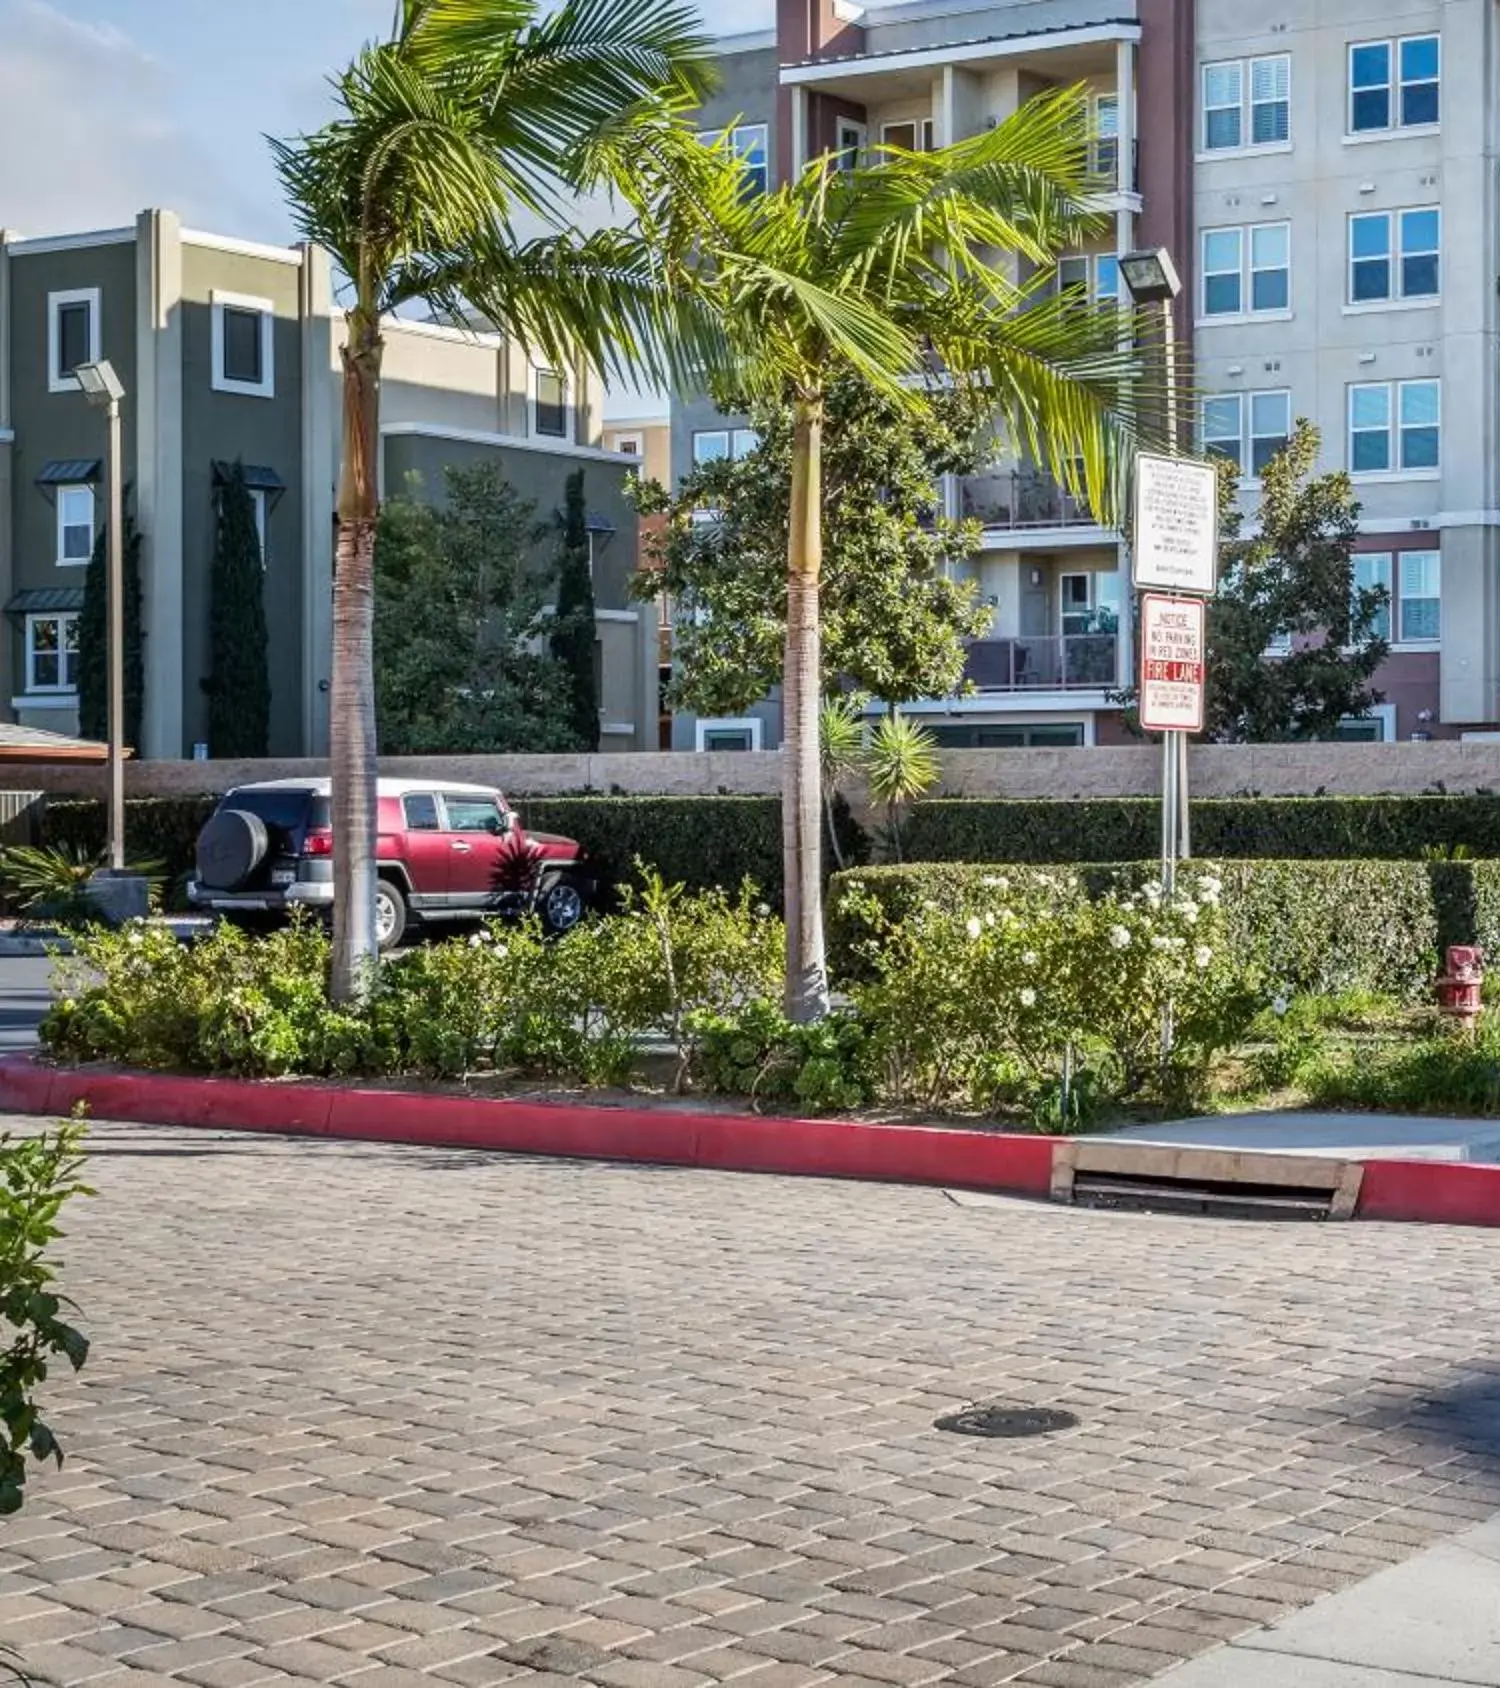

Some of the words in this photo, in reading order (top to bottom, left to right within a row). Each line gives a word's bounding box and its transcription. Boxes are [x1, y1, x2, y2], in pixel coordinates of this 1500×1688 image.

[1160, 612, 1189, 627] NOTICE
[1151, 630, 1162, 643] NO
[1165, 631, 1196, 646] PARKING
[1158, 646, 1173, 658] RED
[1147, 661, 1169, 681] FIRE
[1173, 663, 1200, 684] LANE
